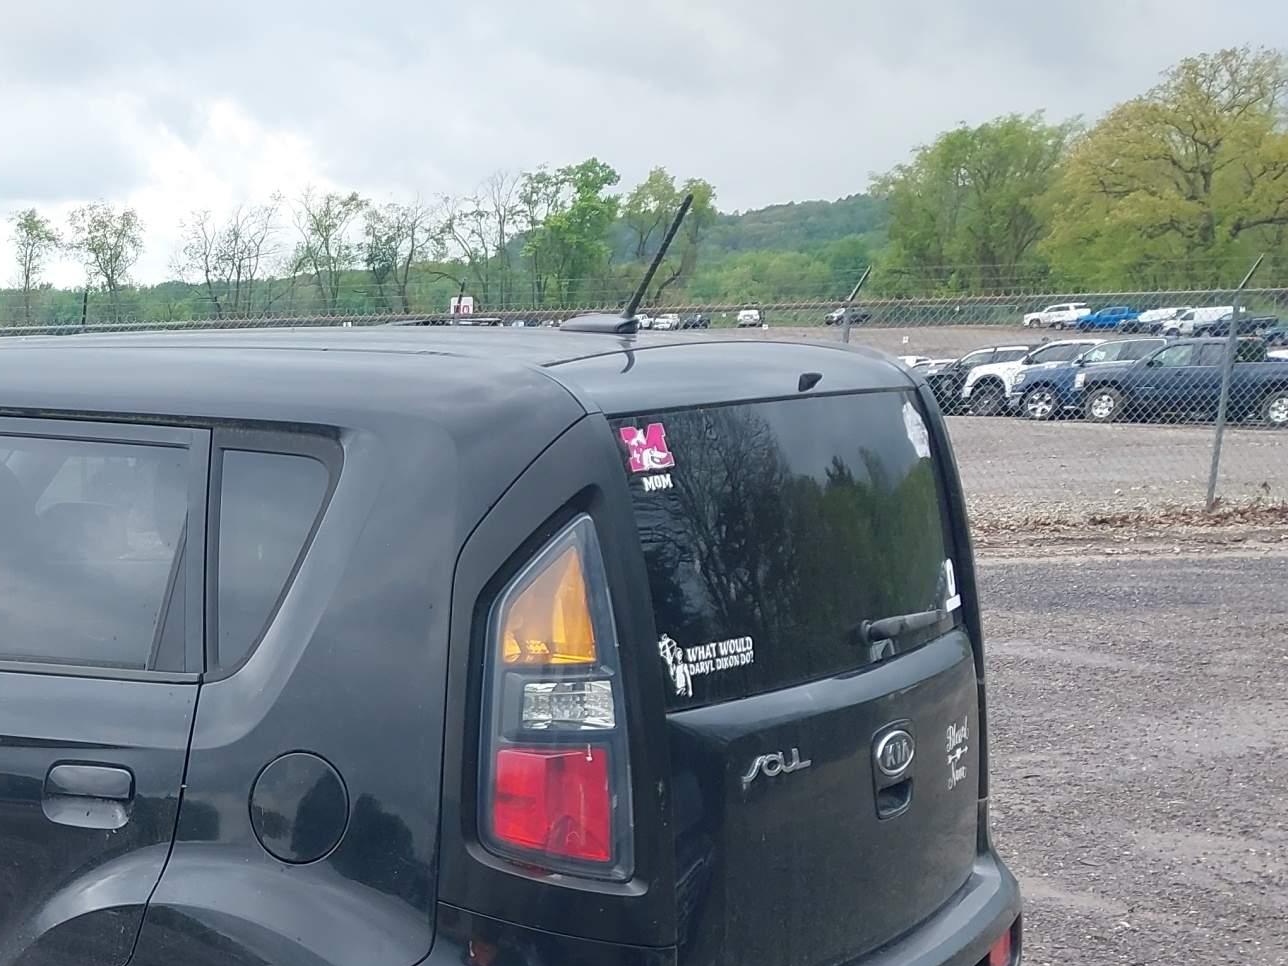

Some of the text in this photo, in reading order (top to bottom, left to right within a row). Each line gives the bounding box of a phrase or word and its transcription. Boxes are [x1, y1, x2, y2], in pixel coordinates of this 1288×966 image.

[642, 473, 673, 491] MOM
[686, 636, 753, 661] WHAT WOULD
[689, 650, 754, 675] DARYL DIXON DO?
[884, 739, 910, 767] KIA
